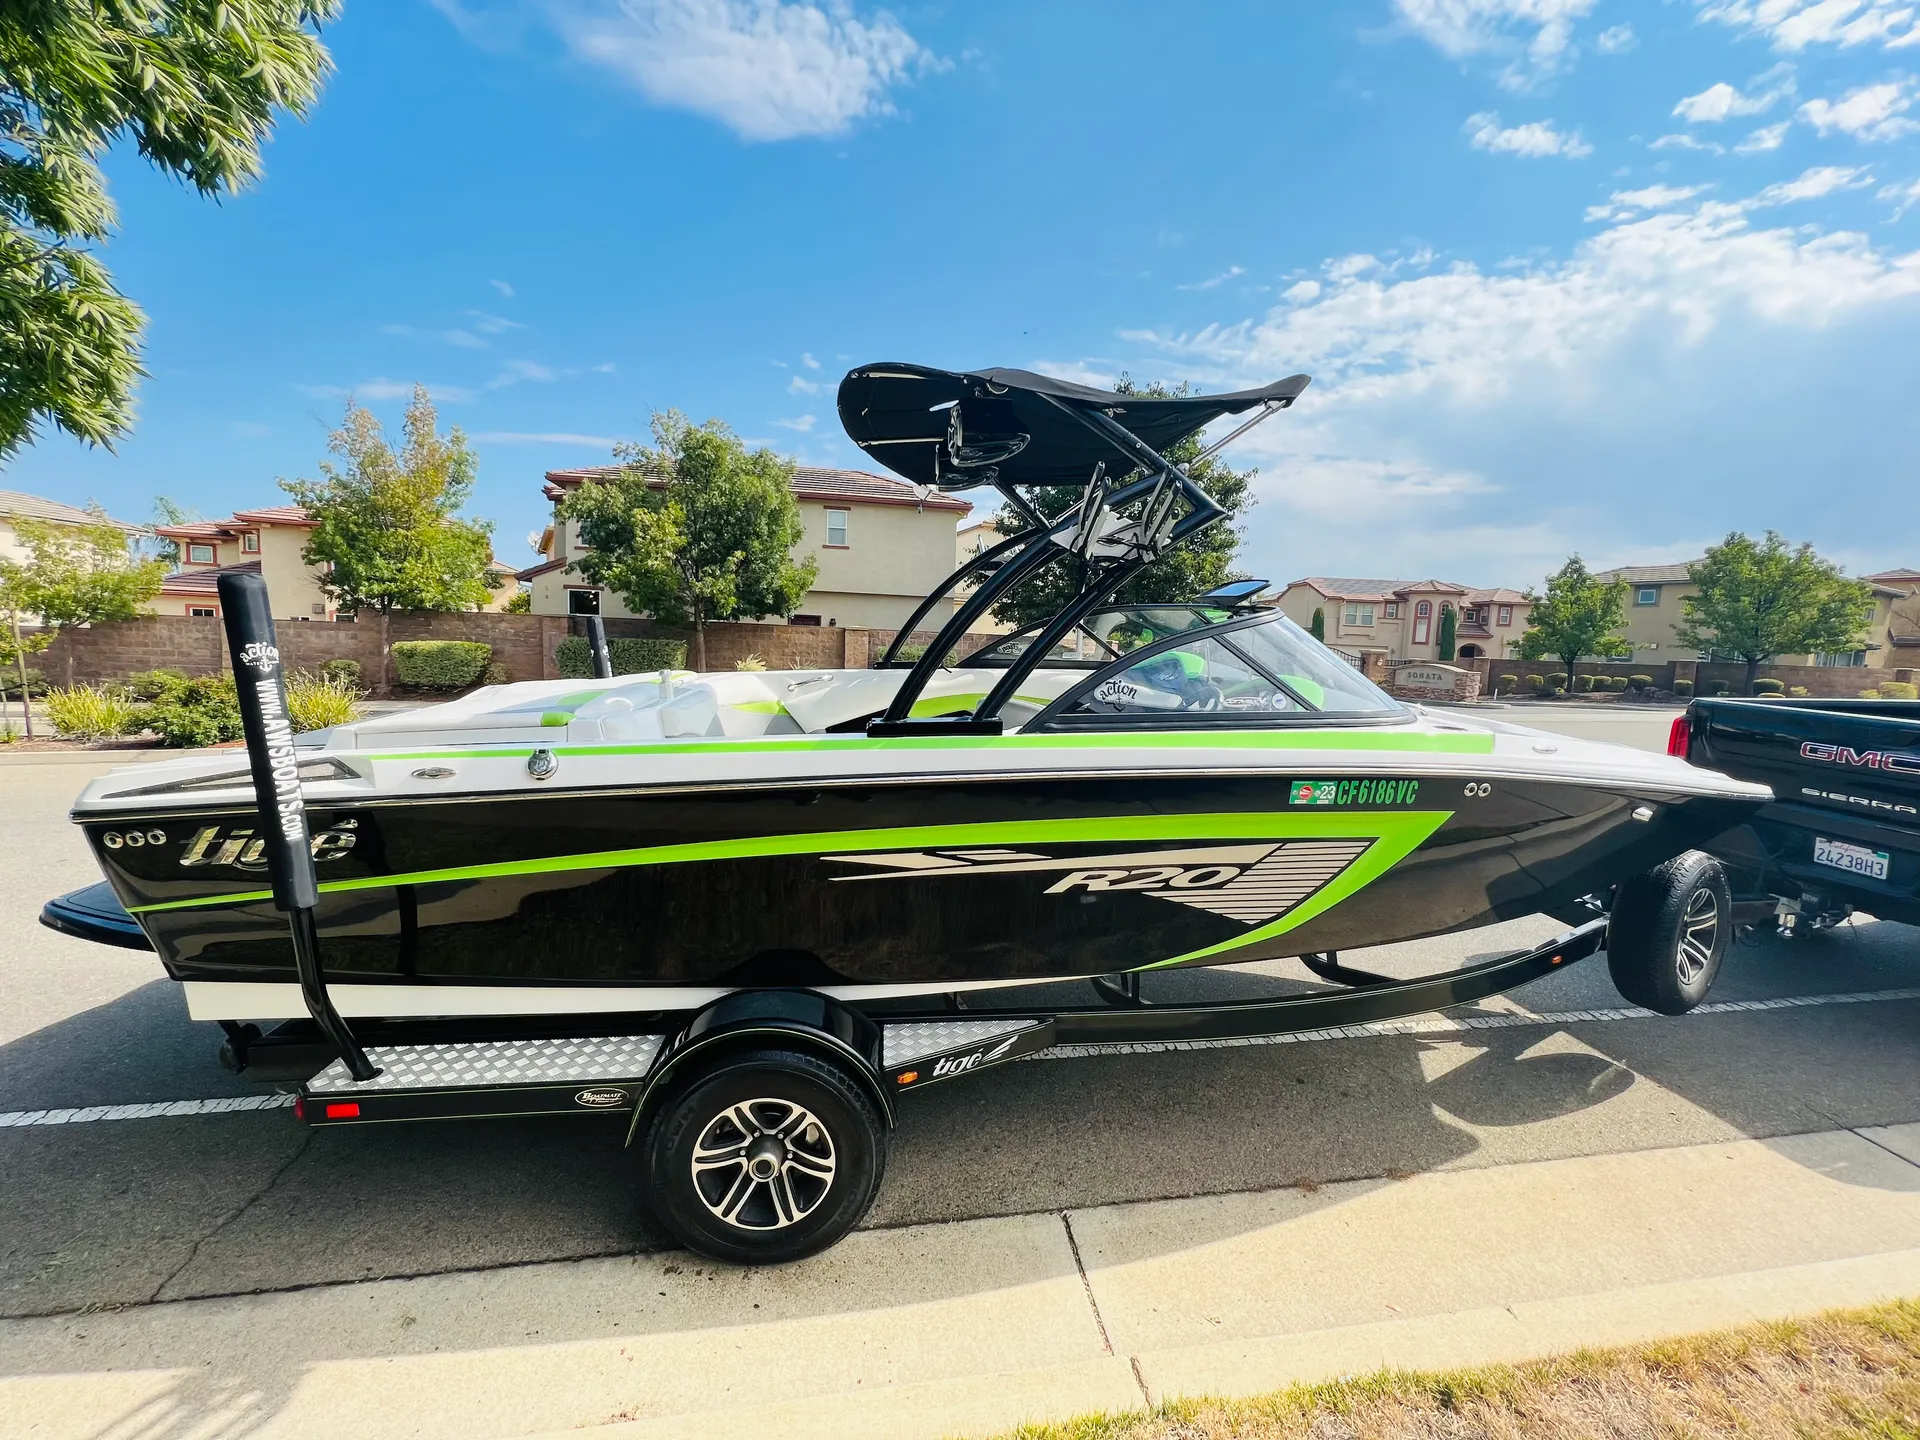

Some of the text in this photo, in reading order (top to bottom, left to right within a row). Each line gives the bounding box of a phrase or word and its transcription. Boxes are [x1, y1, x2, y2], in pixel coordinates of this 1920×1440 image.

[240, 642, 280, 662] action
[1407, 671, 1443, 681] SONATA
[1100, 680, 1137, 701] action
[1800, 741, 1920, 775] GMC
[1320, 785, 1336, 799] 23
[1337, 780, 1419, 805] CF6186VC
[1801, 787, 1917, 814] SIERRA
[1816, 847, 1884, 876] 24238H3
[1043, 866, 1241, 894] R20
[932, 1047, 985, 1077] tigé
